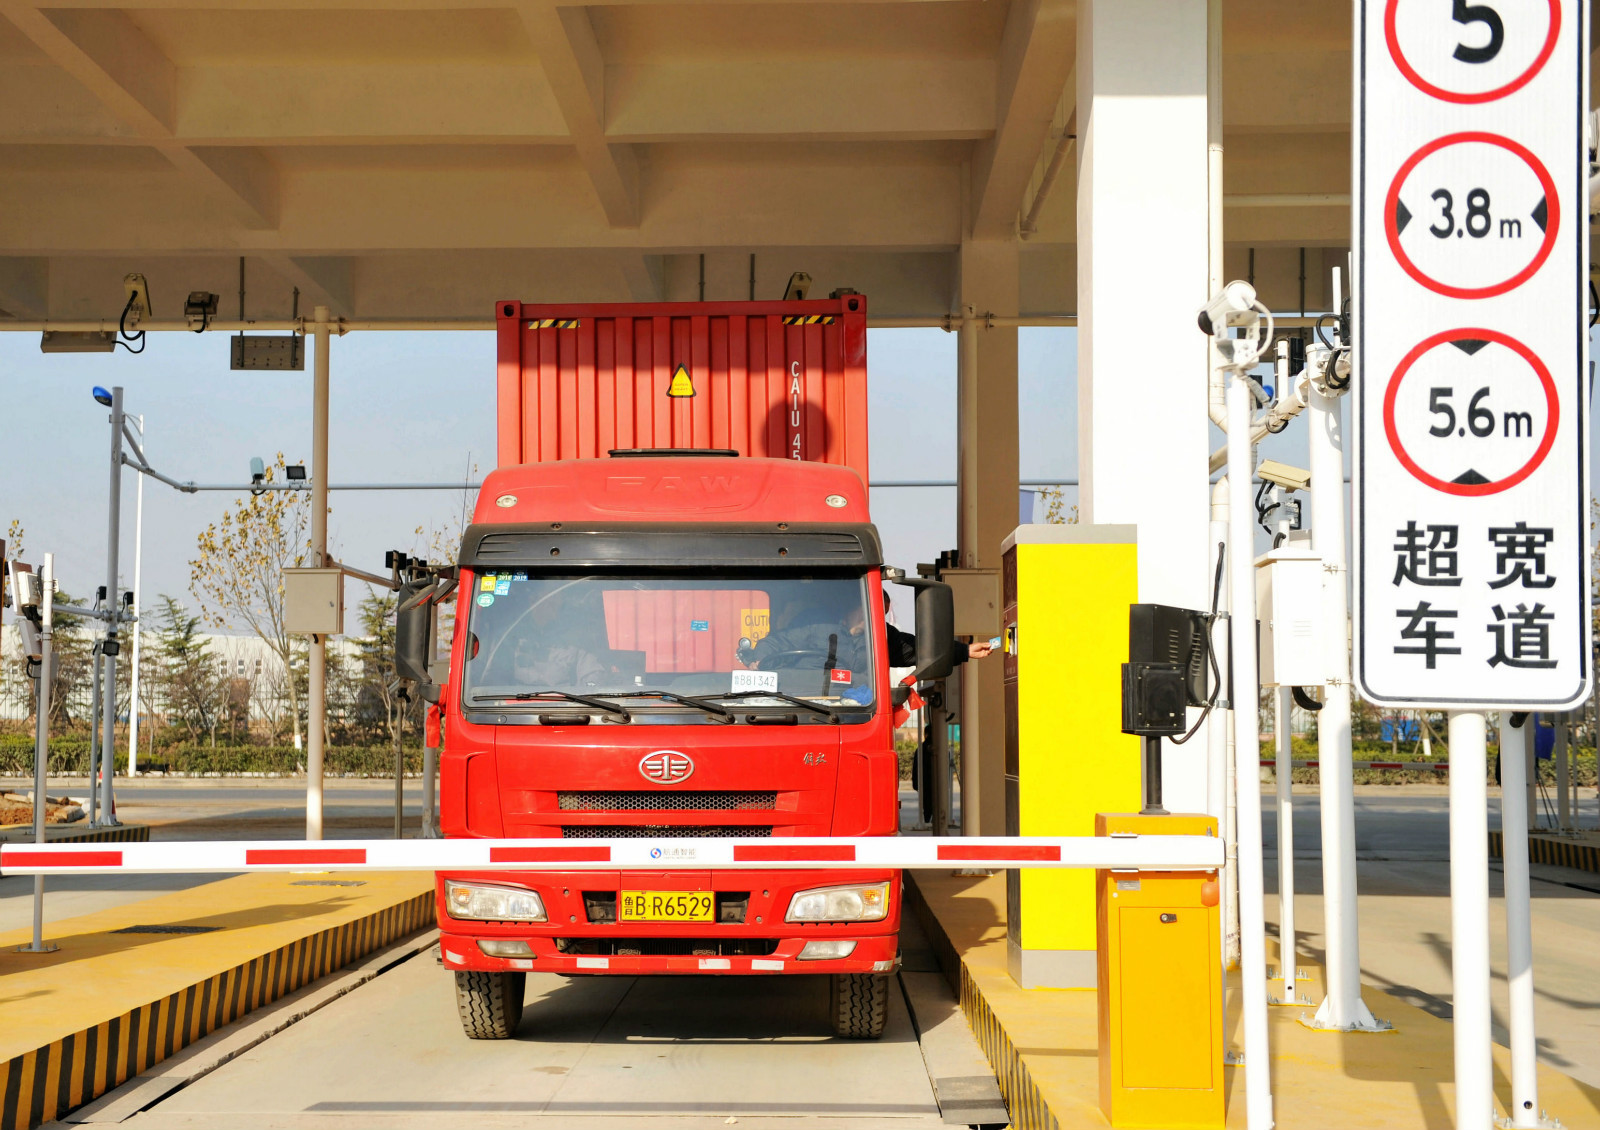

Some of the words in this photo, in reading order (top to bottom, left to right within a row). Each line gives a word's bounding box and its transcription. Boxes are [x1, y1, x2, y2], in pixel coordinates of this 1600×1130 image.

[1452, 0, 1504, 64] 5
[1429, 188, 1522, 239] 3.8m
[790, 360, 800, 427] CAIU
[1429, 386, 1533, 438] 5.6m
[1392, 520, 1557, 590] 超宽
[1393, 600, 1558, 669] 车道
